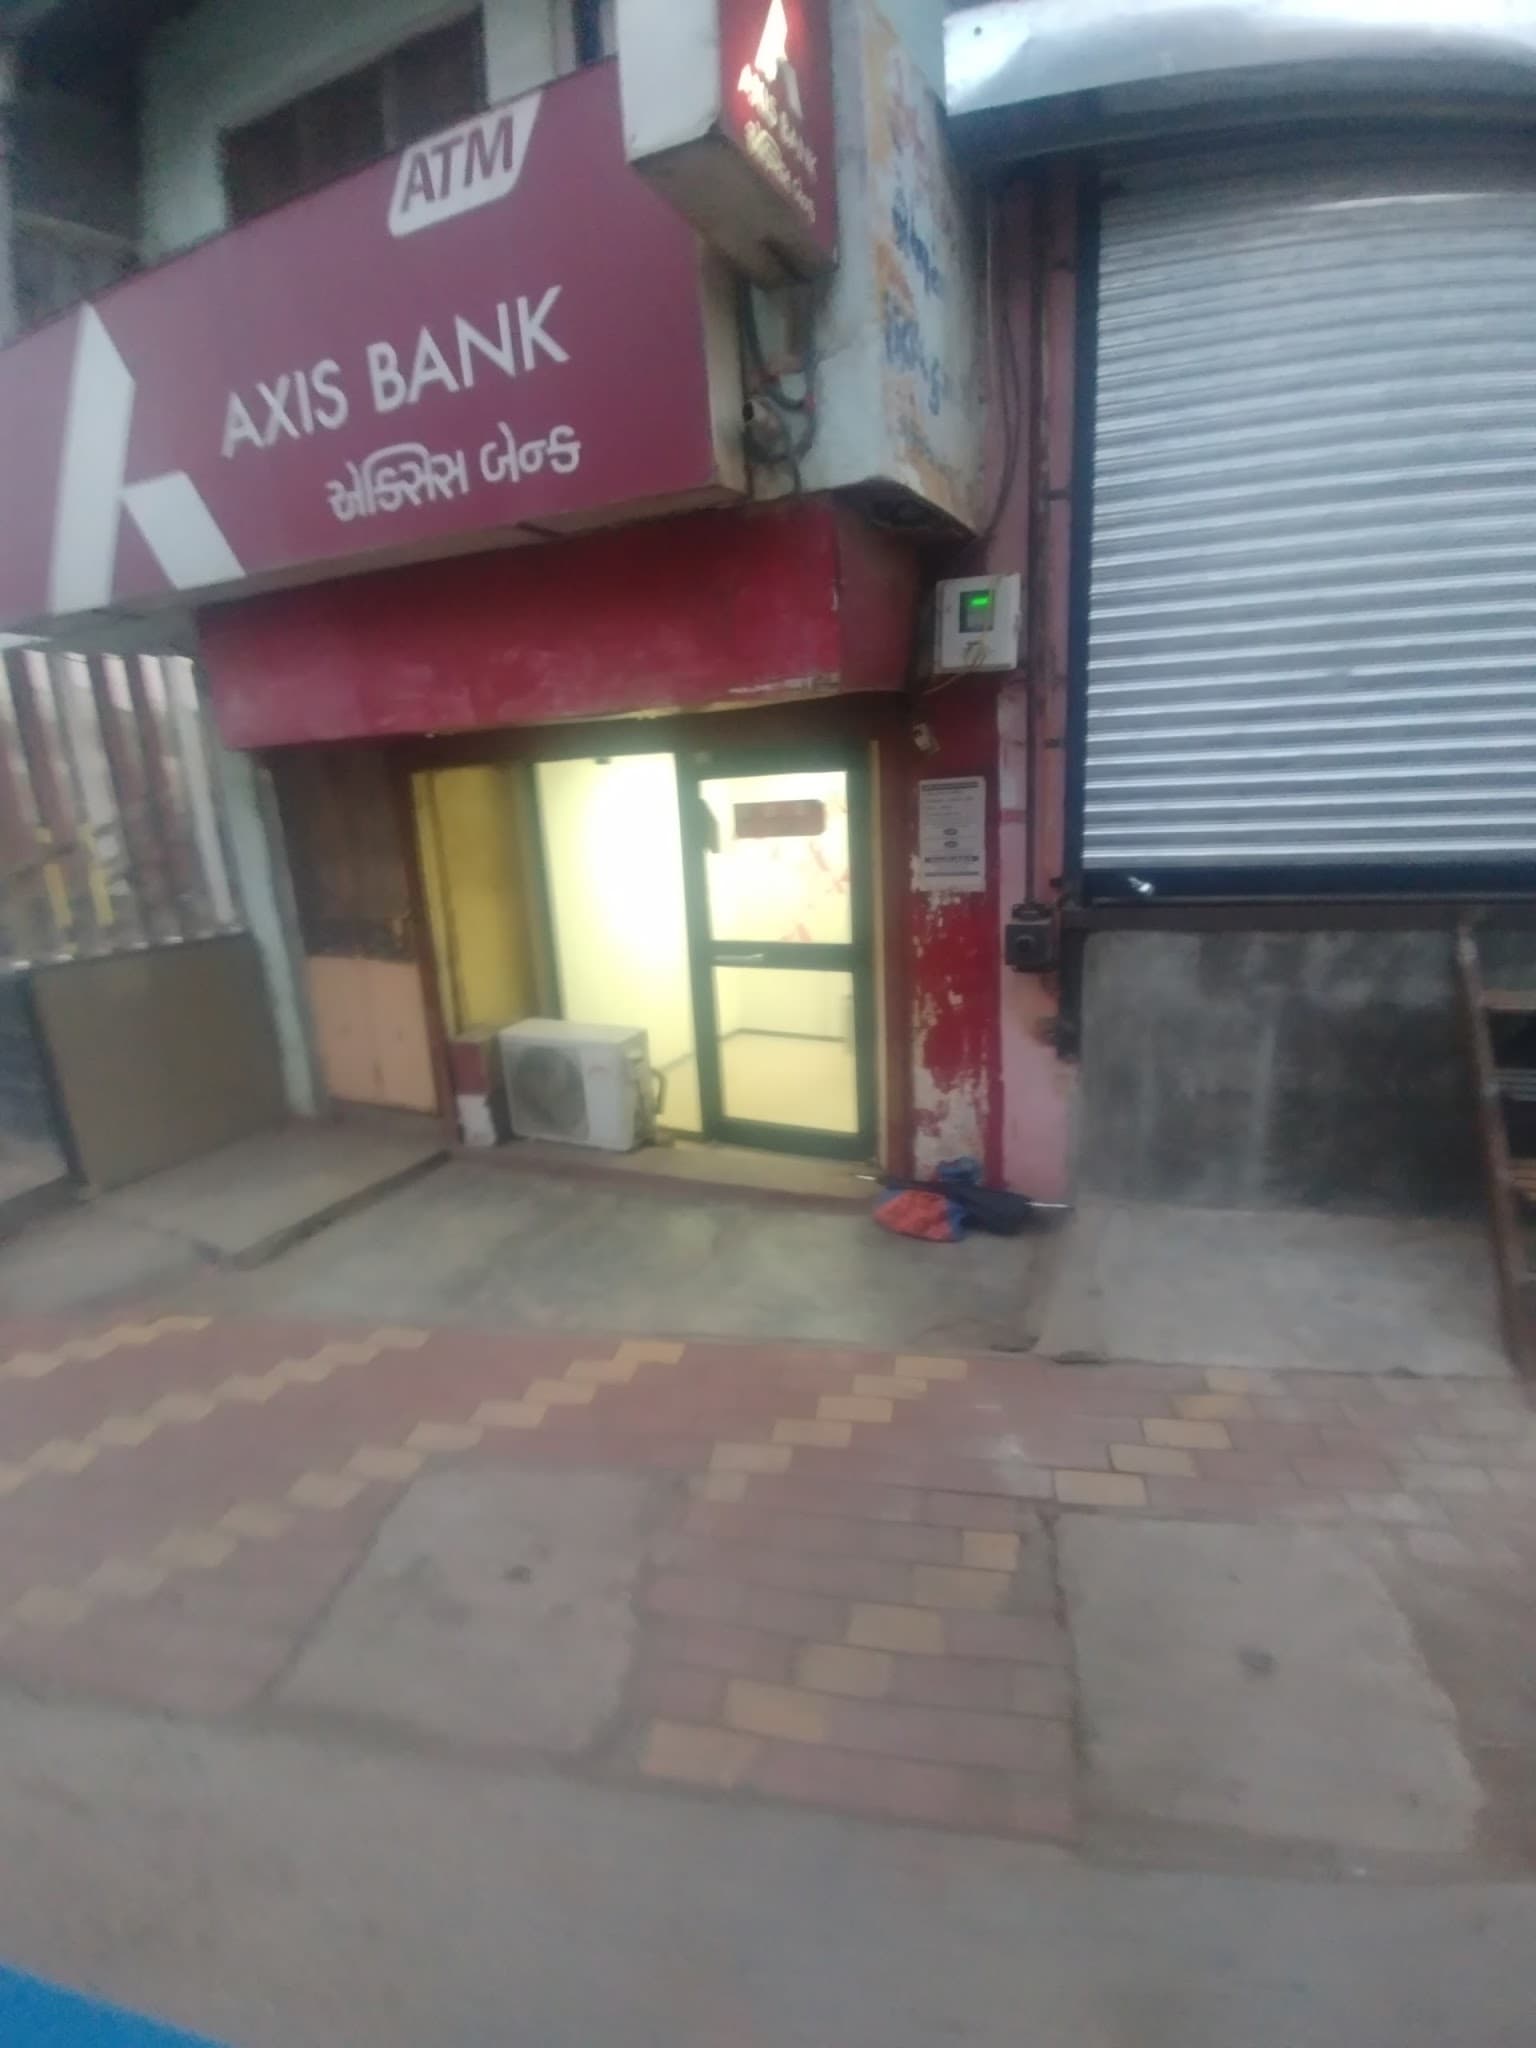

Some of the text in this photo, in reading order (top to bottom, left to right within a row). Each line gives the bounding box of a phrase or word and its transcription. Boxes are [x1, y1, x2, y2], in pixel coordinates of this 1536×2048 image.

[401, 115, 514, 212] ATM
[220, 284, 571, 459] AXIS BANK
